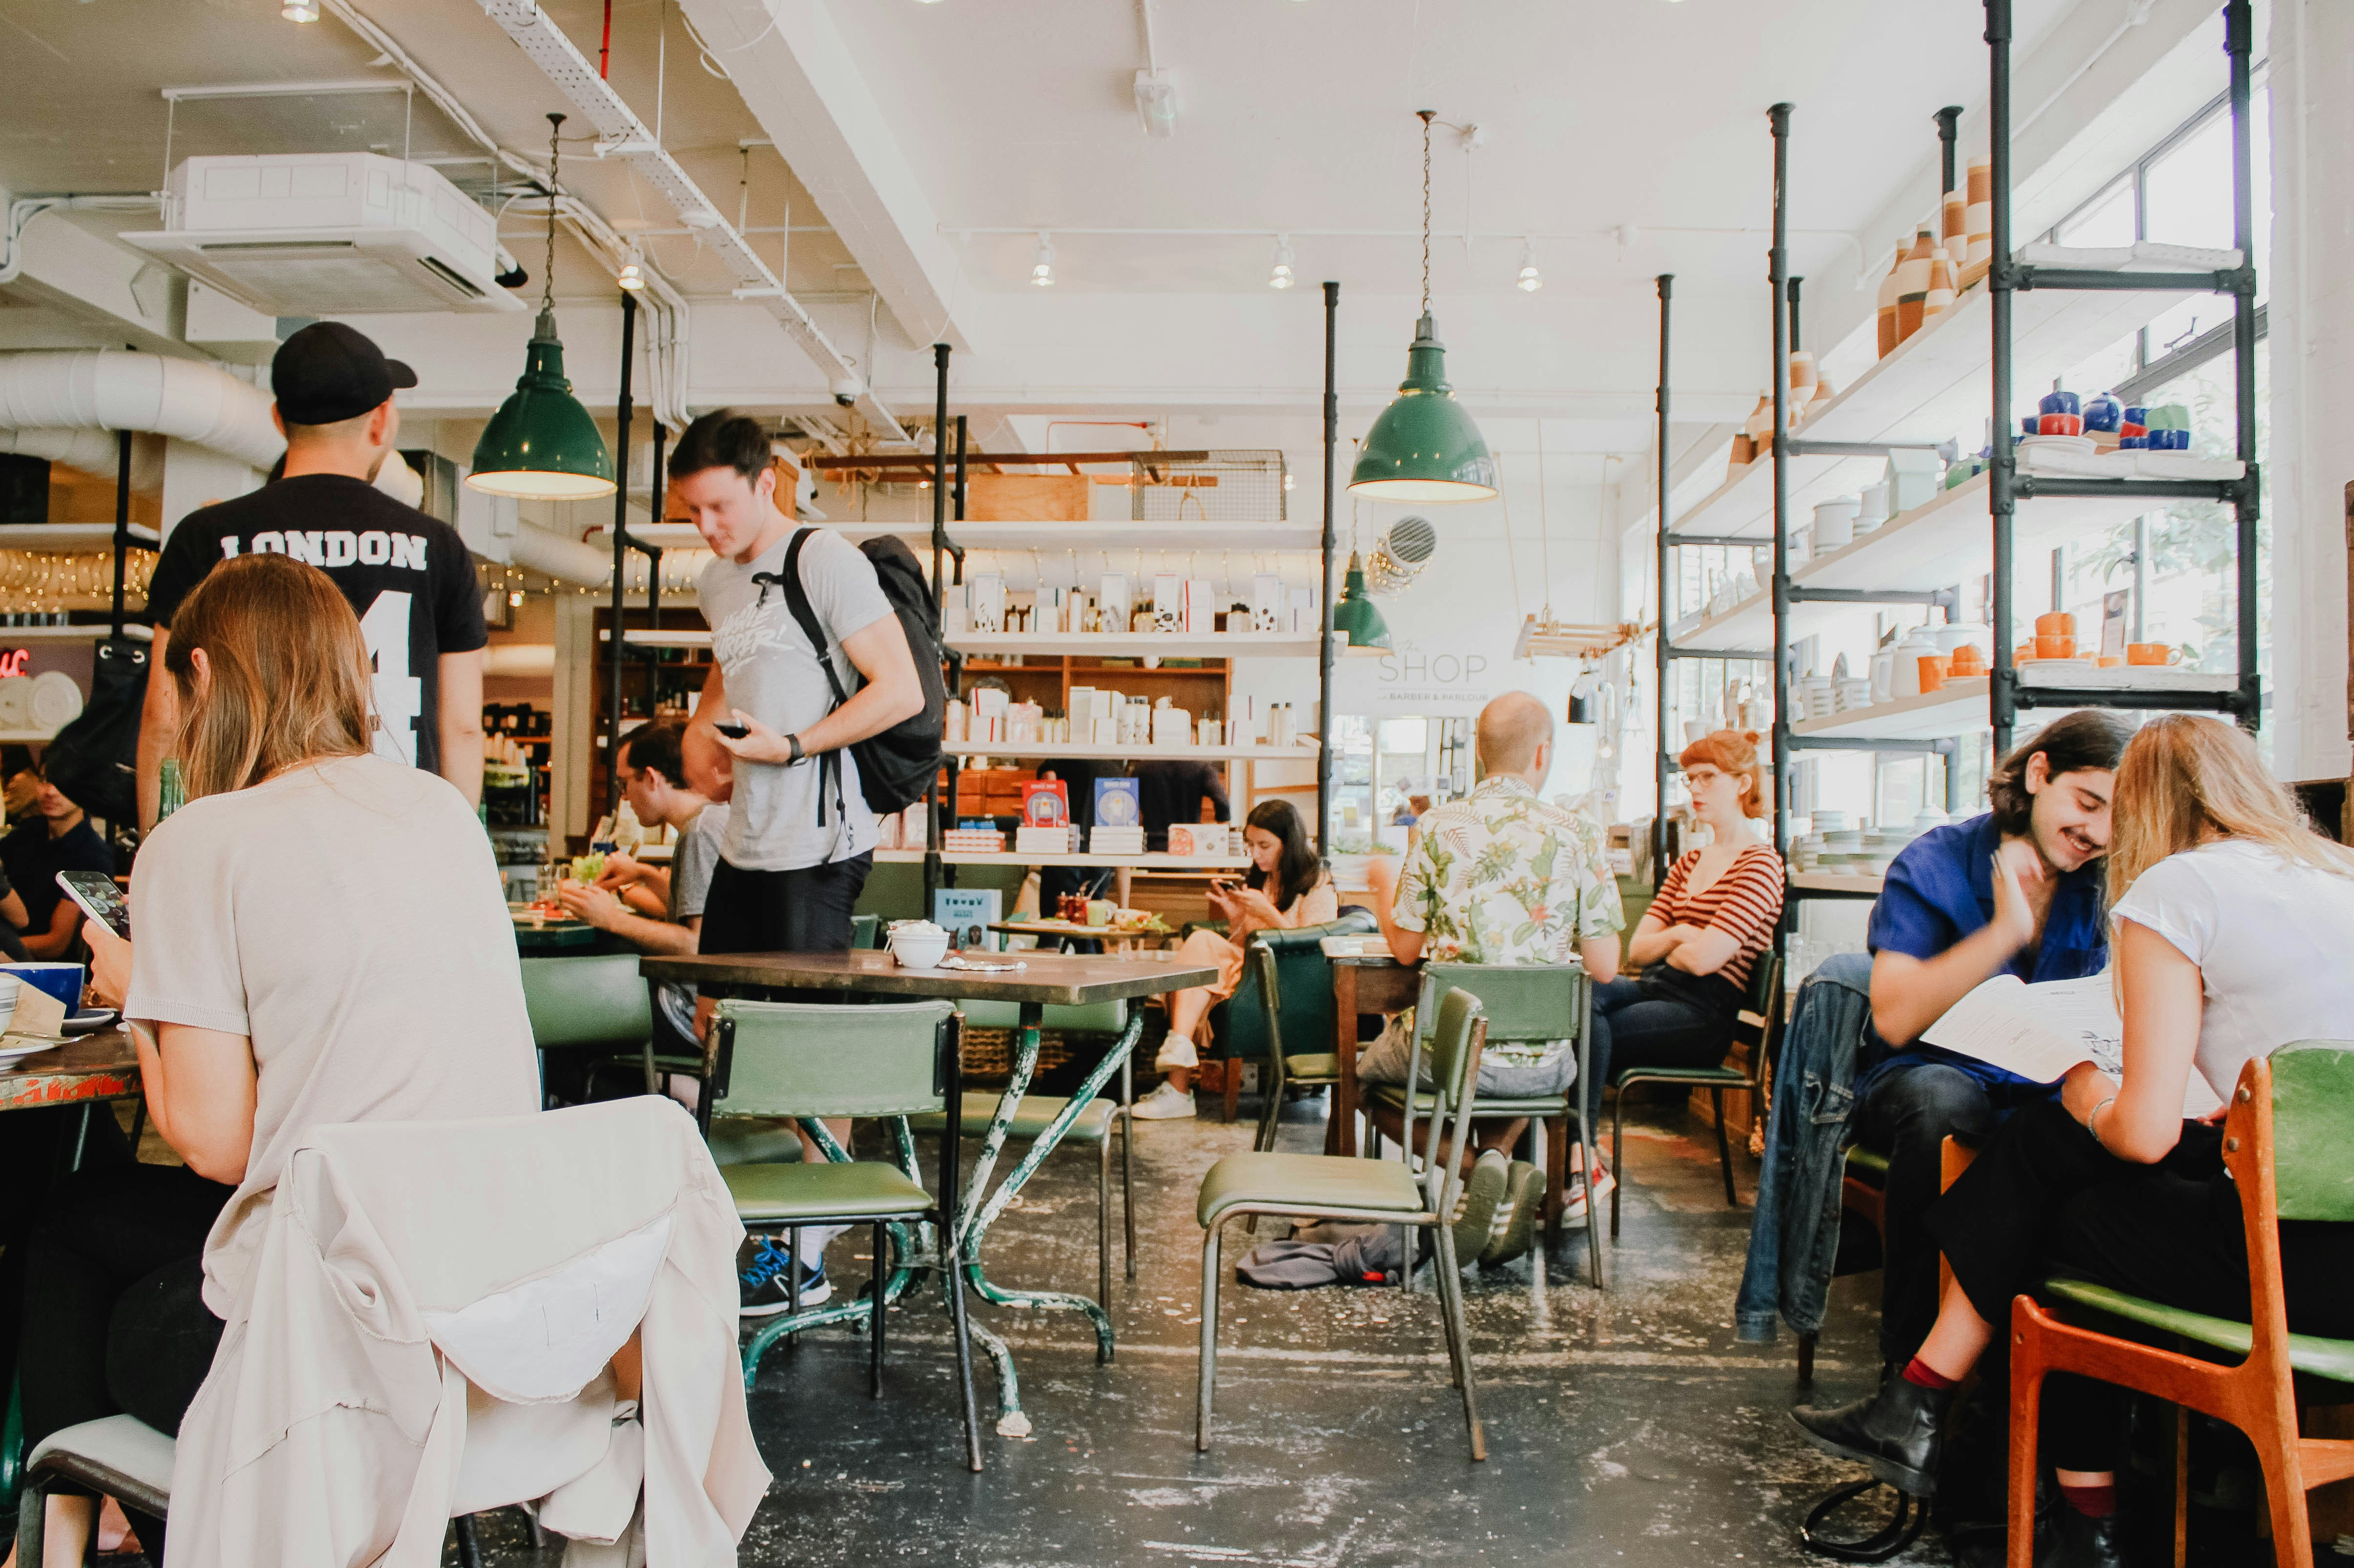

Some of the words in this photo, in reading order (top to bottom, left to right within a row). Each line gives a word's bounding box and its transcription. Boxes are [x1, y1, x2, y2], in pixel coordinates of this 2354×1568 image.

[220, 530, 427, 571] LONDON
[1378, 654, 1487, 683] SHOP
[1442, 693, 1489, 701] PARLOUR
